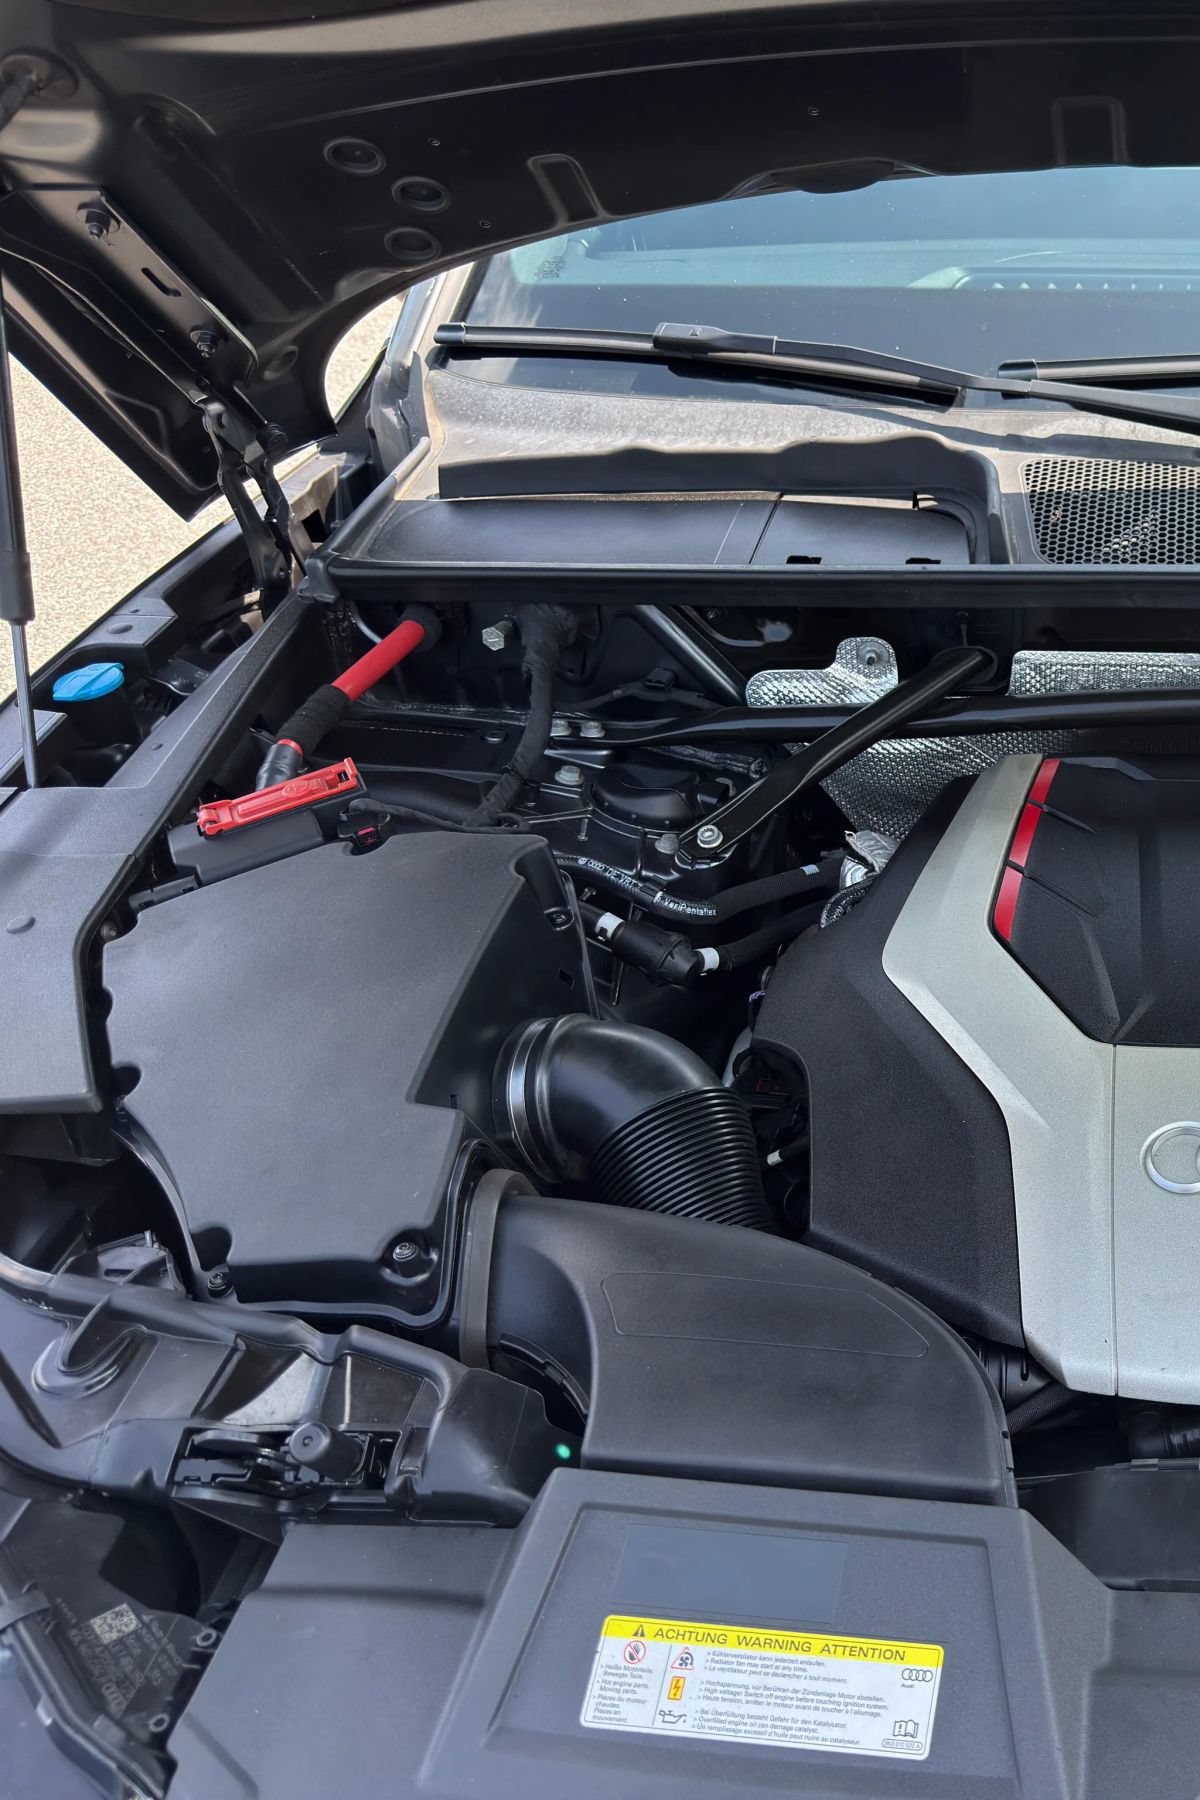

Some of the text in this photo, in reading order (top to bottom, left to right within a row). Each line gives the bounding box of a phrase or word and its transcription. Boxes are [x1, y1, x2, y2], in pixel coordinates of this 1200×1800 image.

[654, 1628, 906, 1661] ACHTUNG WARNING ATTENTION
[763, 1684, 790, 1693] Berühren
[838, 1692, 855, 1700] Motor
[816, 1698, 842, 1706] touching
[770, 1715, 790, 1723] Gefahr
[770, 1723, 793, 1731] damage
